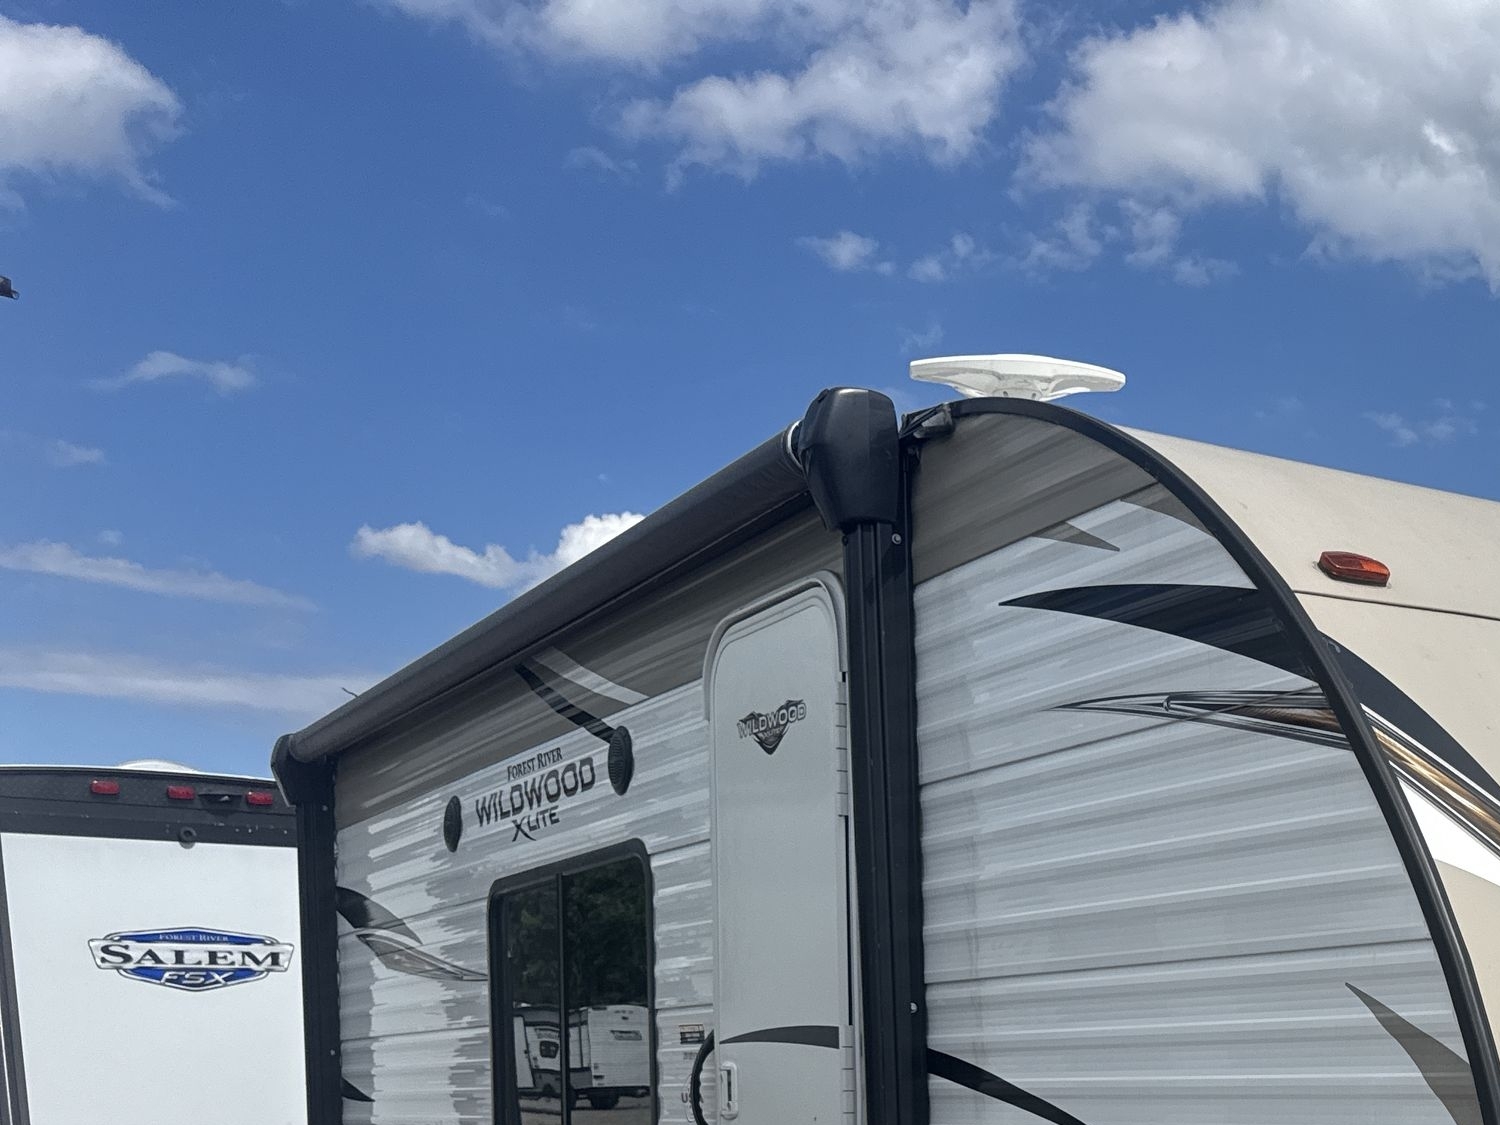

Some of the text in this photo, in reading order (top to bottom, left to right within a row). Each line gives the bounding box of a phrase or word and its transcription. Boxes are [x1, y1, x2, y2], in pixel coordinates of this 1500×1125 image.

[737, 702, 806, 739] WILDWOOD
[507, 747, 563, 781] FOREST RIVER
[475, 756, 596, 828] WILDWOOD
[158, 933, 229, 943] FOREST RIVER
[100, 944, 285, 968] SALEM
[160, 971, 234, 985] FSX
